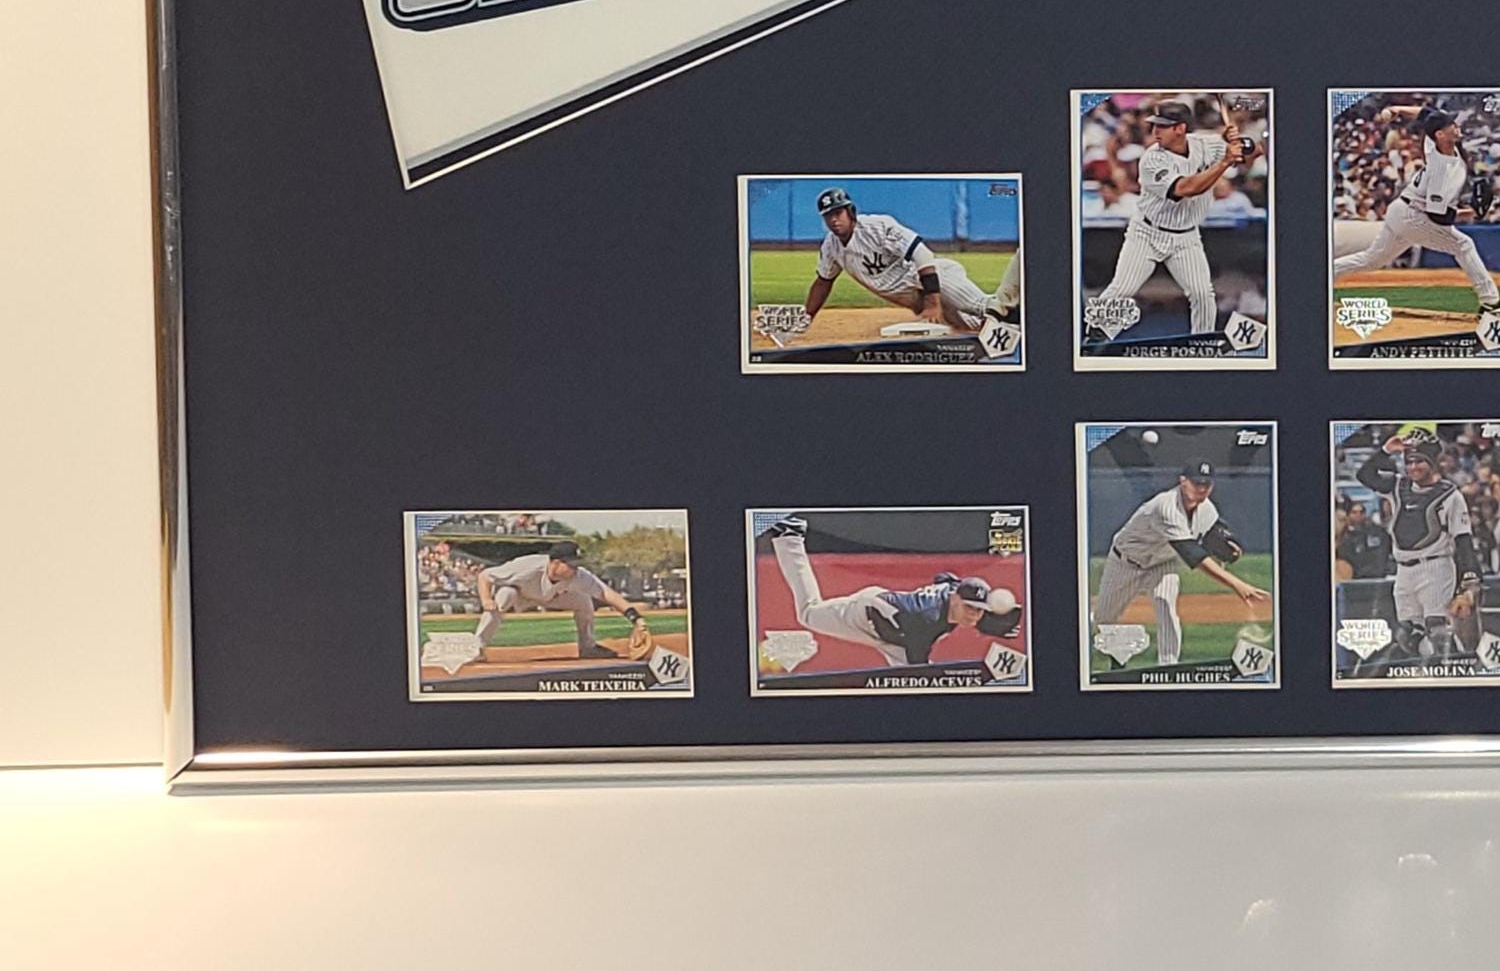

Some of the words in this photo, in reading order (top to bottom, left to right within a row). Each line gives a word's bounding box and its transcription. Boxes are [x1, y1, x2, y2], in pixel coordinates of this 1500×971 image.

[856, 351, 894, 363] ALEX
[1122, 346, 1169, 358] JORGE
[1170, 345, 1224, 357] POSADA
[1369, 346, 1408, 358] ANDY
[1141, 672, 1173, 684] PHIL
[1175, 672, 1232, 684] HUGHES
[1386, 667, 1421, 678] JOSE
[1422, 666, 1477, 678] MOLINA
[538, 680, 581, 691] MARK
[582, 679, 647, 691] TEIXEIRA
[865, 677, 929, 688] ALFREDO
[929, 677, 983, 688] ACEVES
